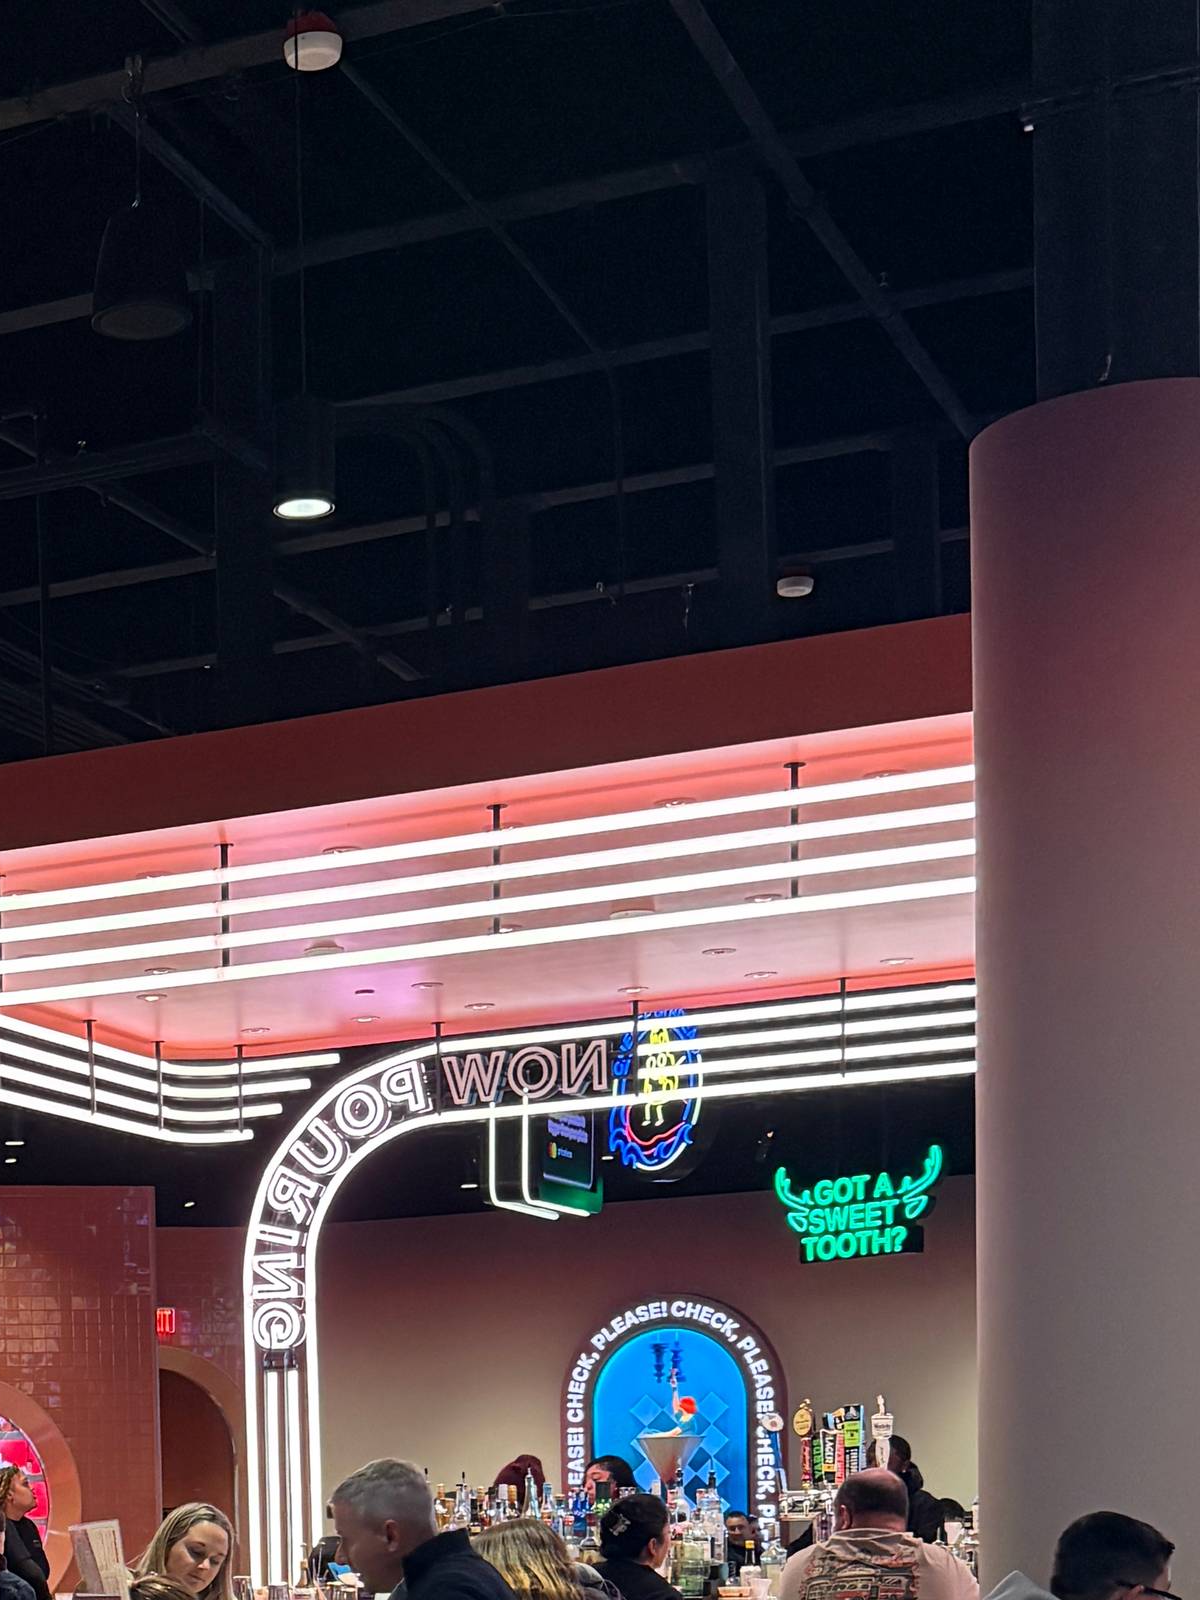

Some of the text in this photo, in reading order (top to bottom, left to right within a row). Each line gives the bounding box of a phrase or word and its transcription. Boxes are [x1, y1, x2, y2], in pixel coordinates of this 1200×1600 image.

[813, 1172, 894, 1206] GOT A
[808, 1199, 900, 1234] SWEET
[801, 1225, 908, 1262] TOOTH?
[590, 1301, 668, 1351] PLEASE!
[670, 1300, 741, 1342] CHECK,
[566, 1352, 600, 1423] CHECK,
[566, 1427, 585, 1486] EASE!
